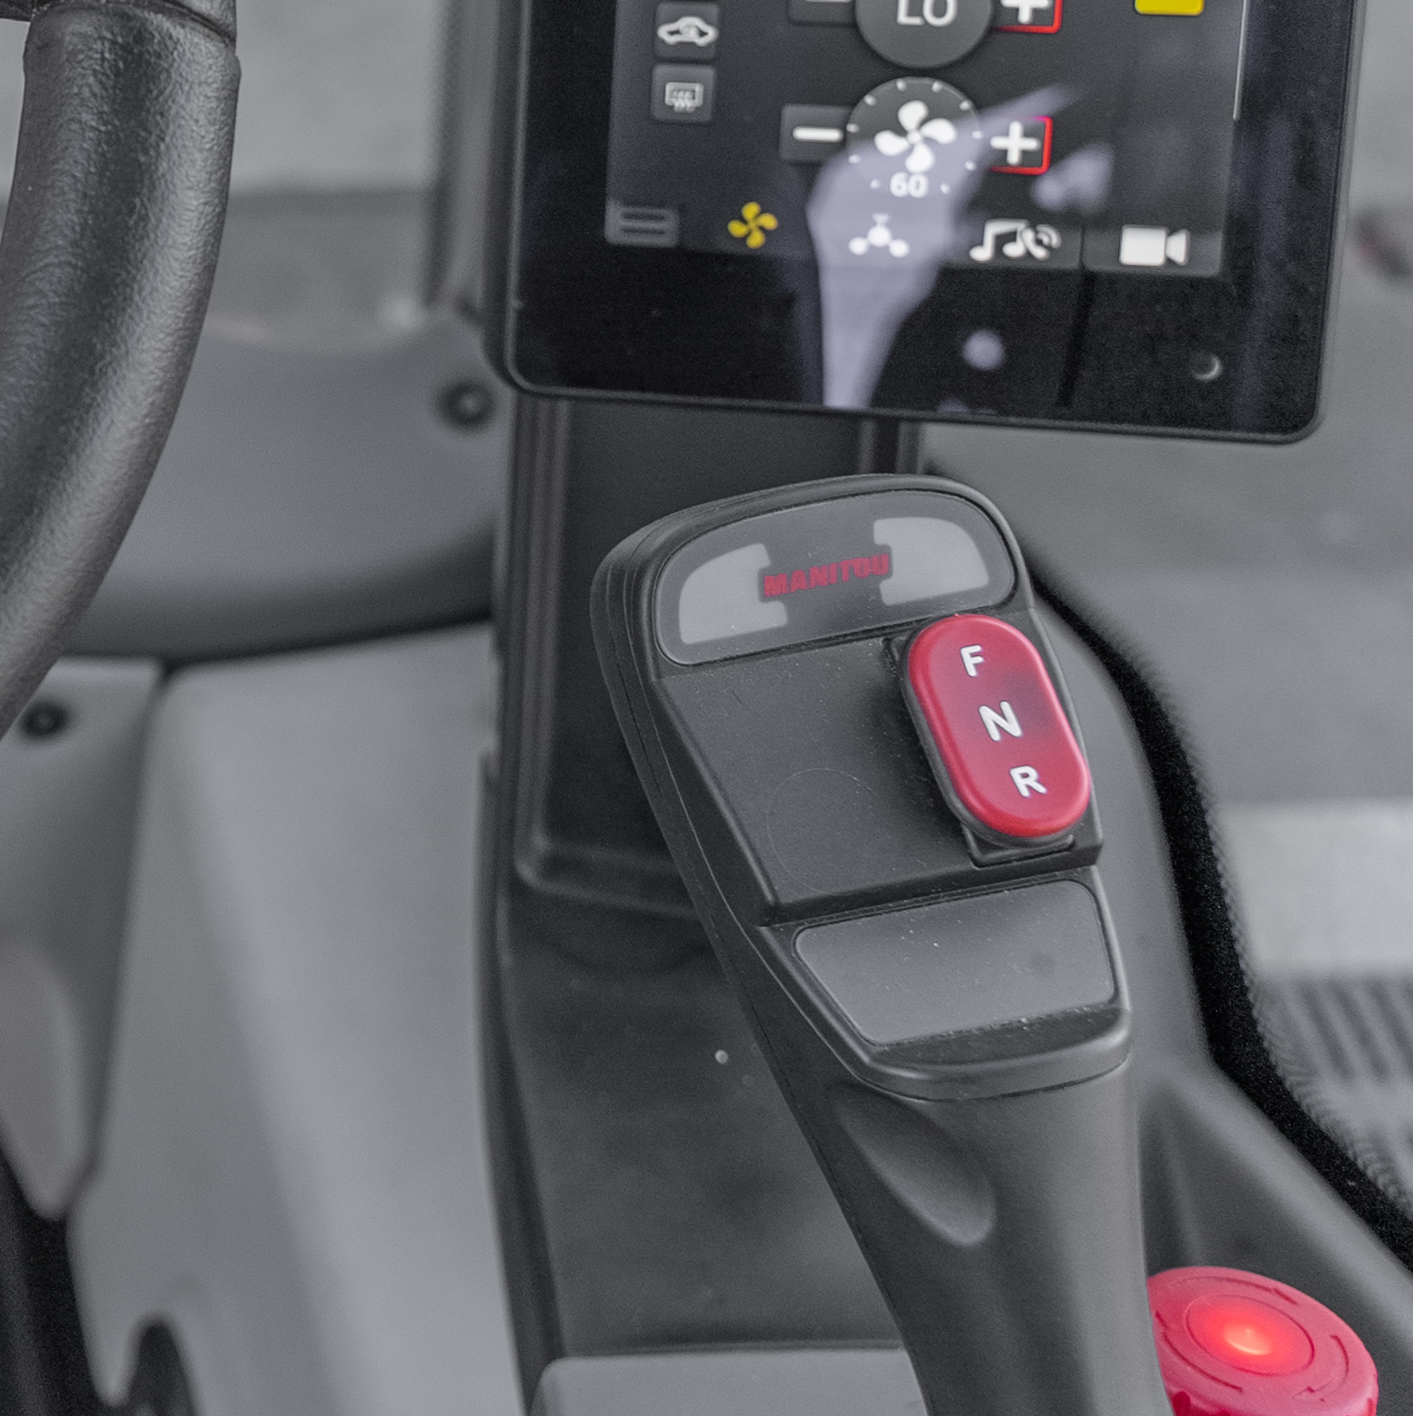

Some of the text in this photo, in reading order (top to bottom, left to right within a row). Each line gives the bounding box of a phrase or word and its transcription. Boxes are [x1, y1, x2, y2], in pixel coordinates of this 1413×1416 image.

[889, 171, 929, 198] 60
[764, 553, 889, 597] MANITOU
[960, 644, 984, 677] F
[978, 700, 1022, 742] N
[1009, 765, 1047, 797] R
